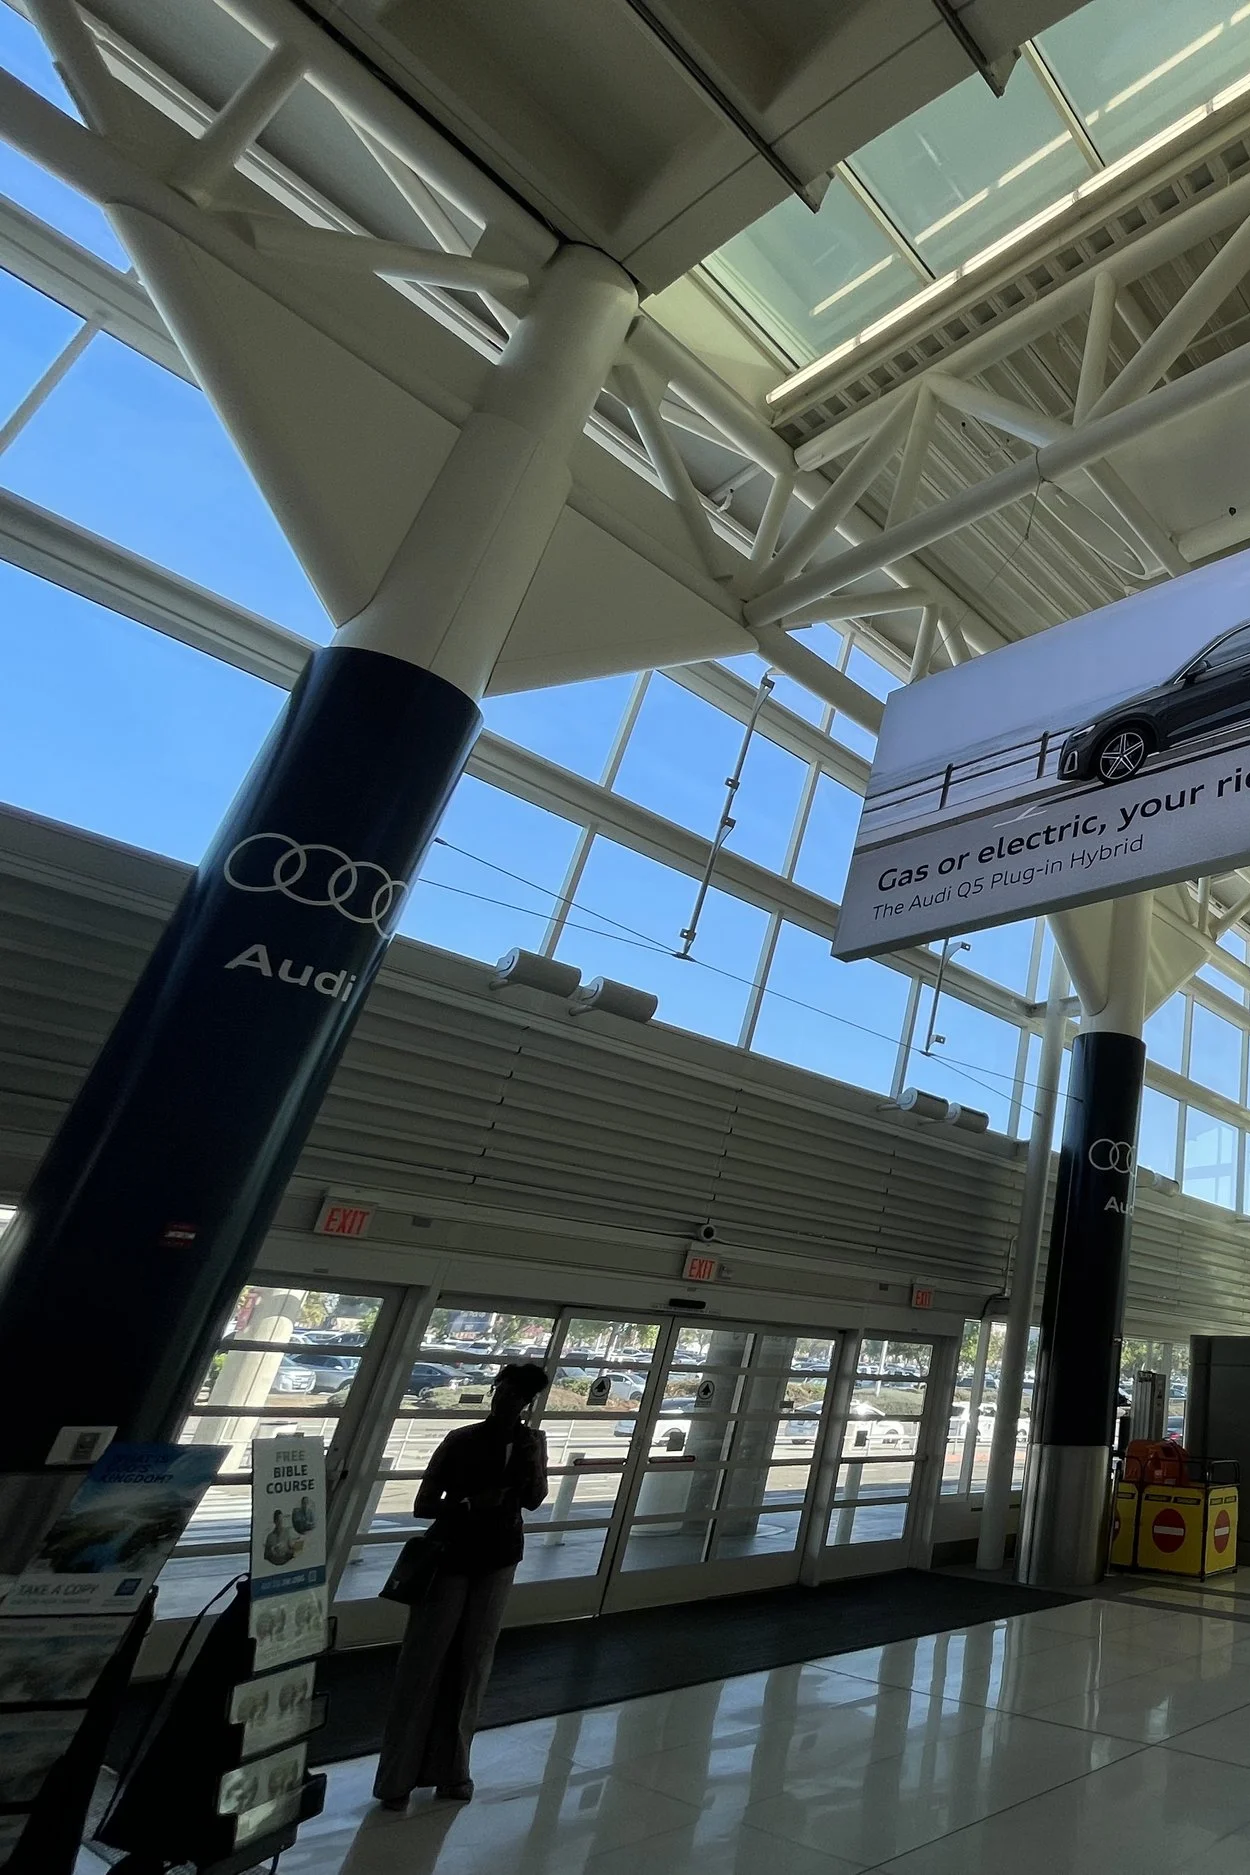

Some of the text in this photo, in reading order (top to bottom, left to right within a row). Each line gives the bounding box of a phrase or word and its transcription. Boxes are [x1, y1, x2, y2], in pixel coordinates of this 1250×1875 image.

[877, 864, 930, 892] Gas
[937, 851, 972, 876] or
[977, 812, 1107, 864] electric,
[1116, 783, 1205, 833] your
[872, 834, 1144, 921] The Audi Q5 Plug-in Hybrid
[223, 943, 357, 1003] Audi
[323, 1206, 370, 1236] EXIT
[688, 1257, 716, 1281] EXIT
[914, 1288, 932, 1308] EXIT
[275, 1450, 306, 1463] FREE
[273, 1465, 309, 1479] BIBLE
[266, 1479, 315, 1495] COURSE
[19, 1583, 100, 1596] TAKE A COPY
